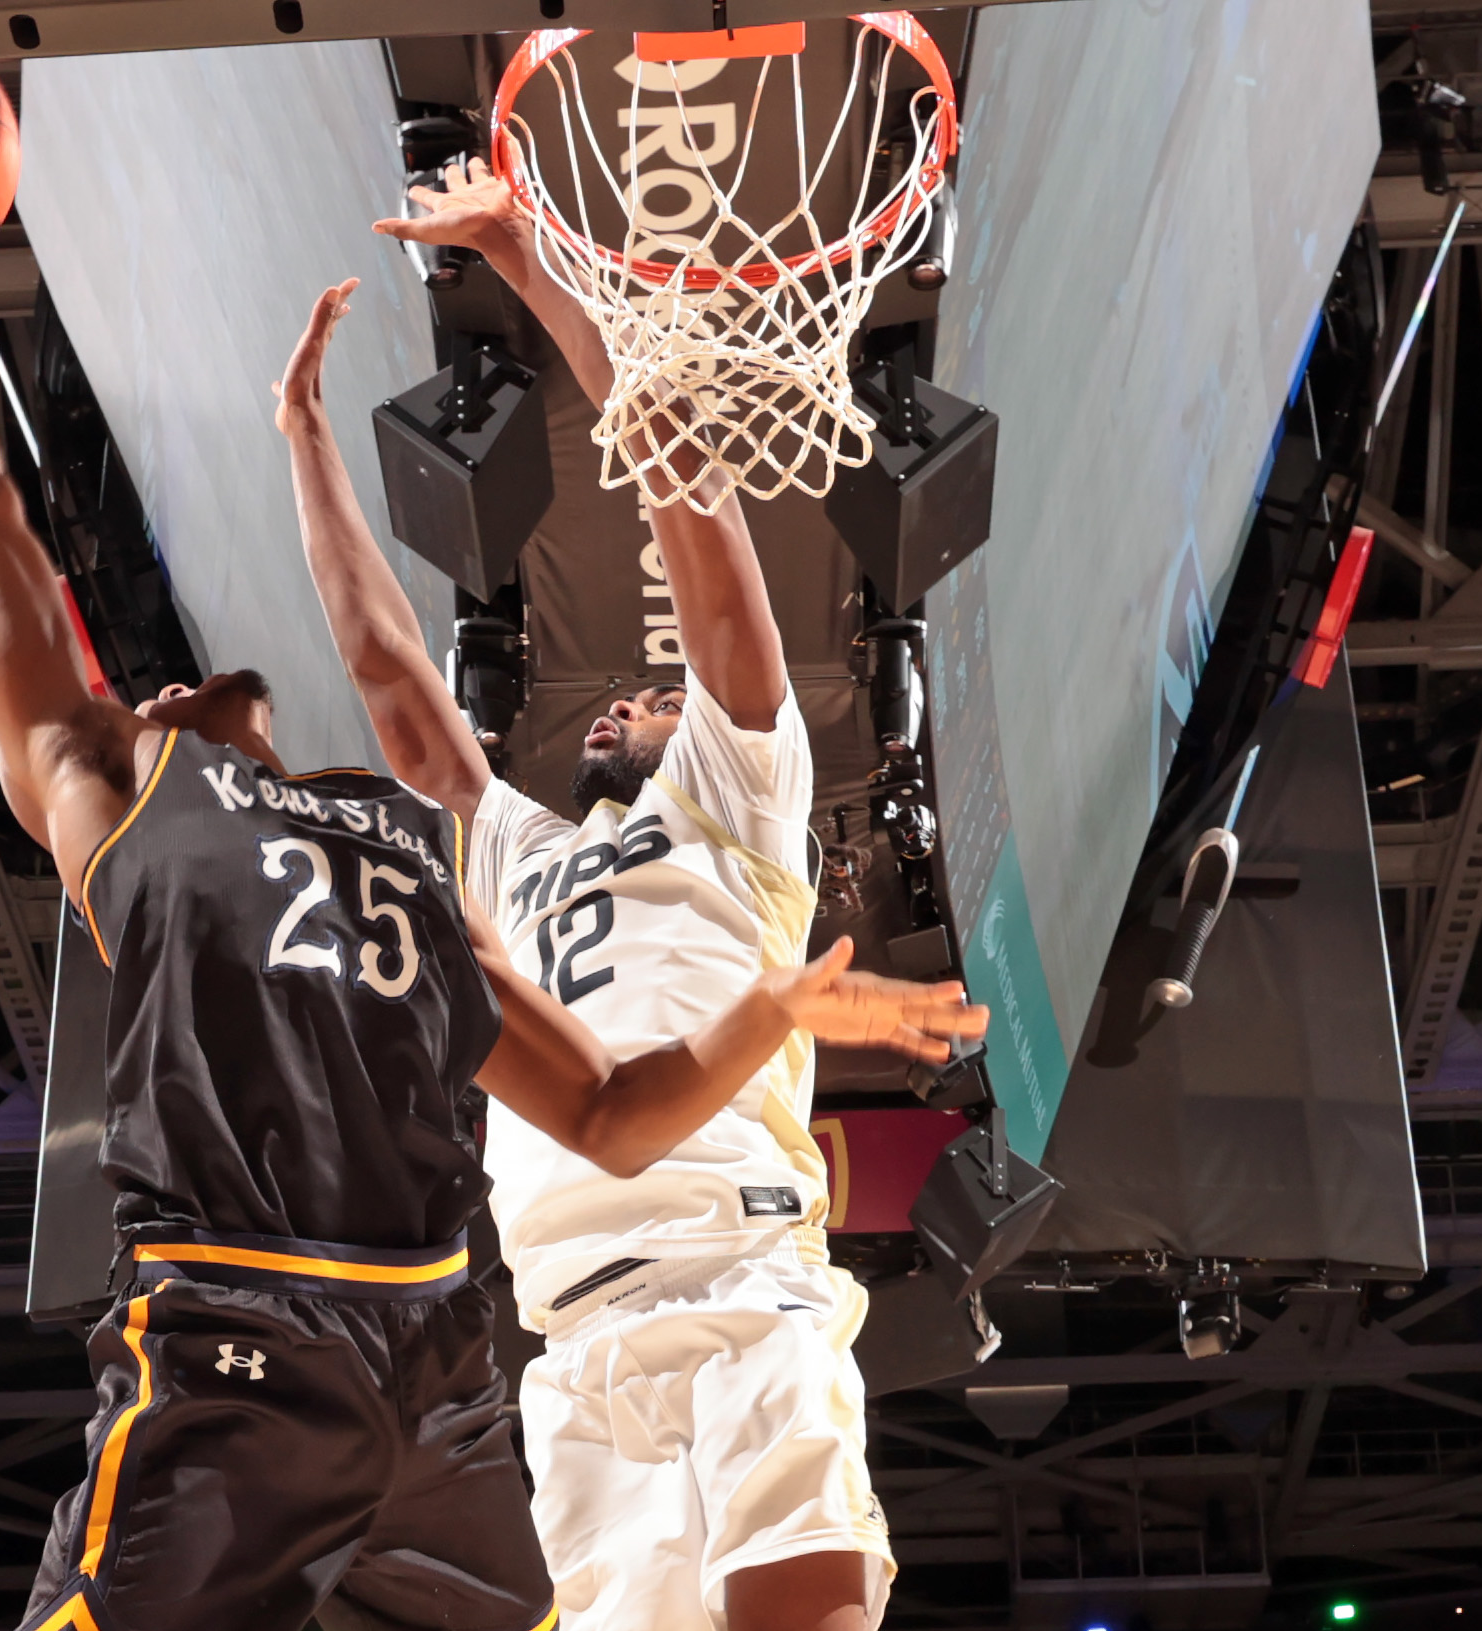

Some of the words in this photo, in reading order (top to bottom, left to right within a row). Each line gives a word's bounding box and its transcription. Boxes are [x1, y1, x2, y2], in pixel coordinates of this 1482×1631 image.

[200, 761, 330, 823] Kent
[334, 798, 450, 885] State
[255, 832, 421, 1000] 25
[537, 889, 614, 1006] 12
[607, 1282, 646, 1307] AKRON
